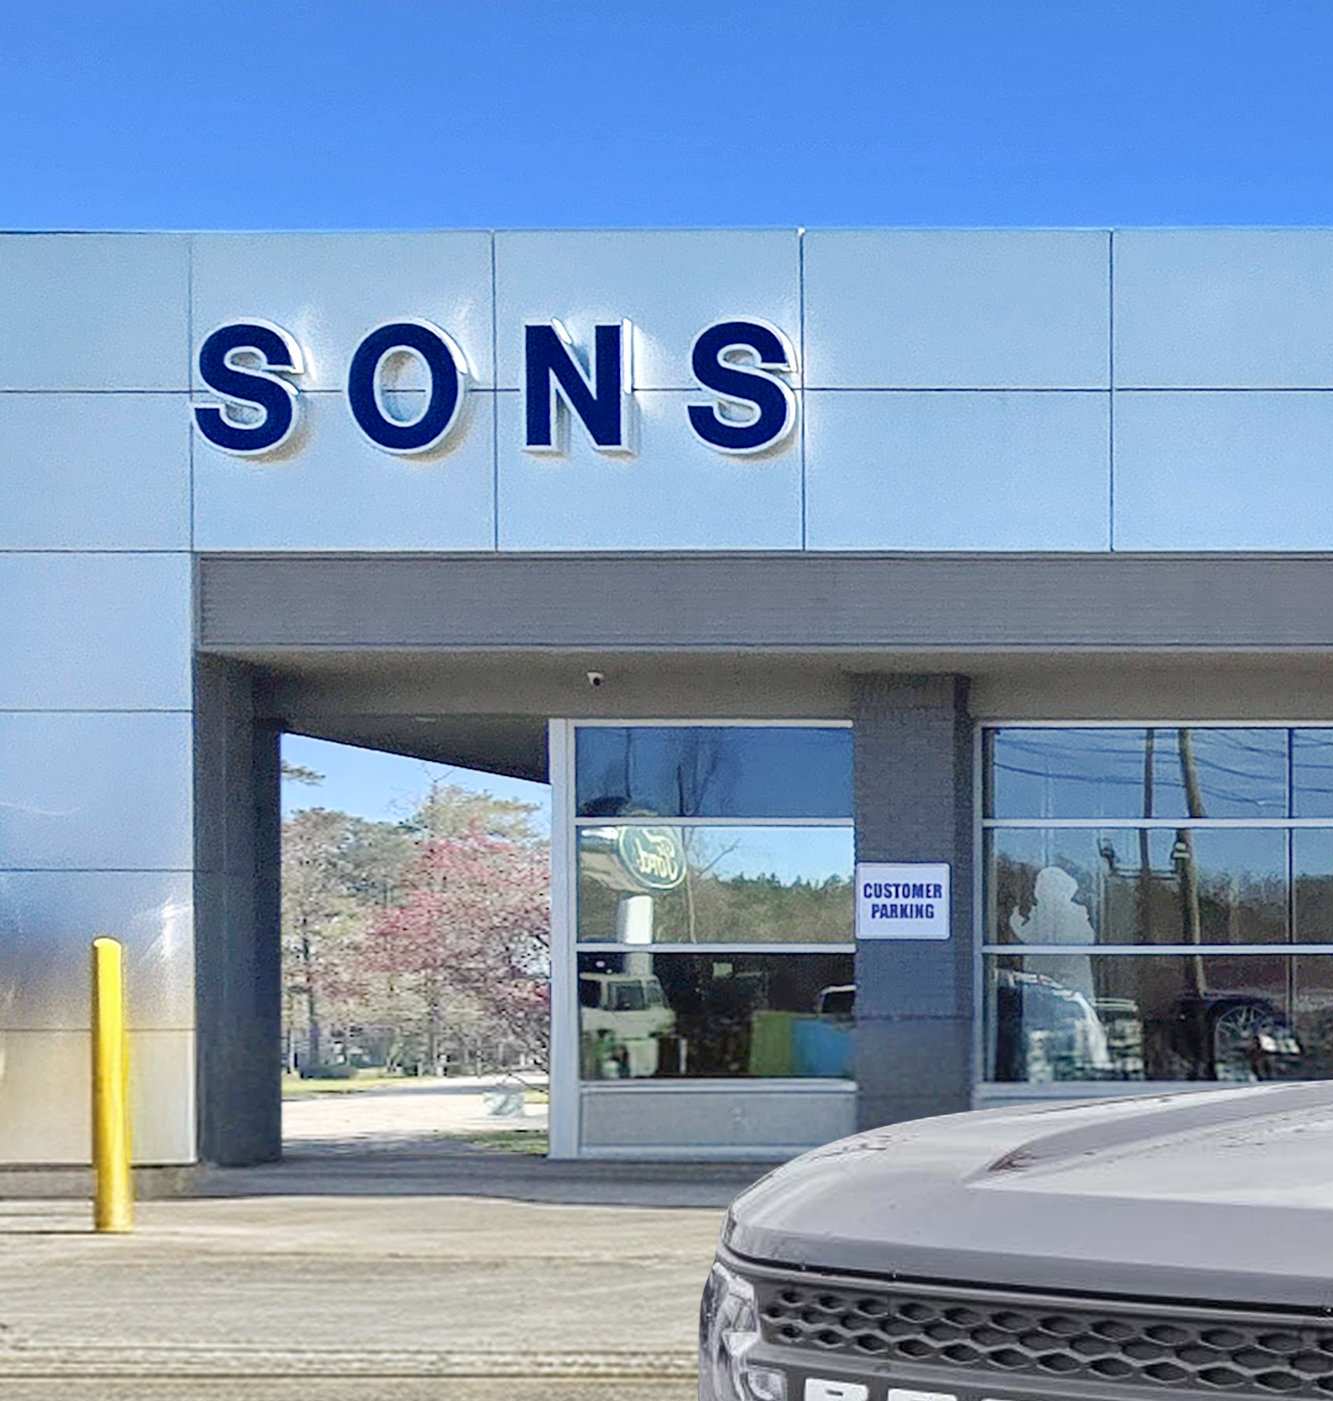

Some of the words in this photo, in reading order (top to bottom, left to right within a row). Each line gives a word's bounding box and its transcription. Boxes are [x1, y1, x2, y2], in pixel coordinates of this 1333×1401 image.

[193, 319, 796, 453] SONS
[863, 882, 943, 899] CUSTOMER
[871, 903, 935, 919] PARKING
